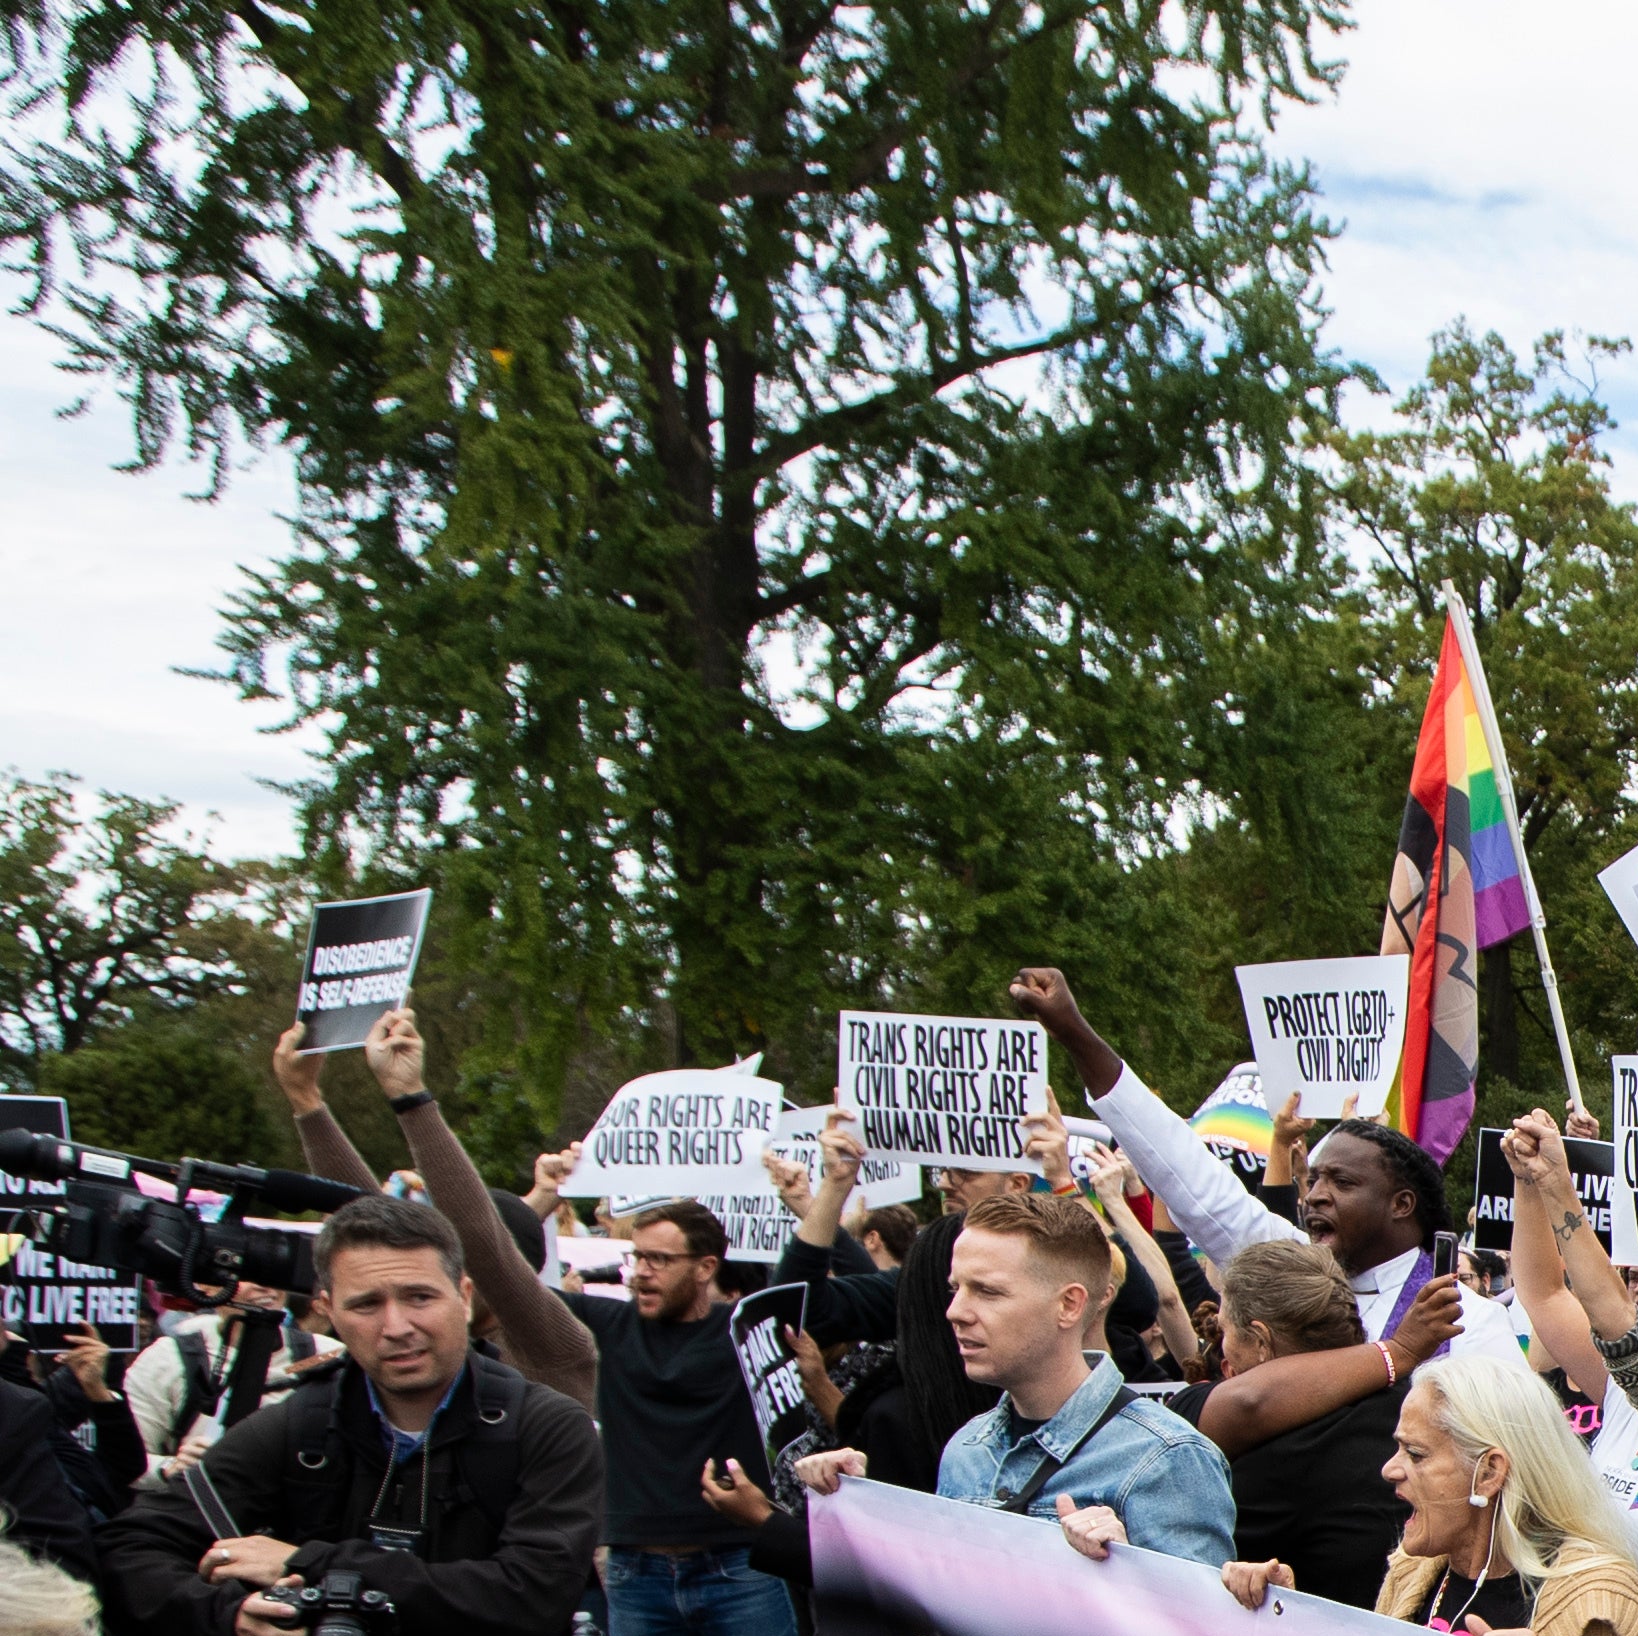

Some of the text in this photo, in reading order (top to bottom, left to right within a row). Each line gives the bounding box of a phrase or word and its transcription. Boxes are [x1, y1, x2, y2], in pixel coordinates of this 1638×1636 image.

[313, 936, 413, 975] DISOBEDIENCE
[299, 970, 409, 1011] IS SELF-DEFENSE
[1262, 990, 1395, 1041] PROTECT LGBTQ+
[848, 1021, 1038, 1073] TRANS RIGHTS ARE
[1296, 1038, 1383, 1082] CIVIL RIGHTS
[856, 1065, 1028, 1116] CIVIL RIGHTS ARE
[650, 1095, 724, 1128] RIGHTS
[732, 1098, 773, 1132] ARE
[863, 1109, 942, 1154] HUMAN
[946, 1115, 1023, 1158] RIGHTS
[594, 1130, 659, 1168] QUEER
[669, 1130, 743, 1165] RIGHTS
[16, 1238, 54, 1278] WE
[29, 1286, 84, 1324] LIVE
[87, 1286, 138, 1324] FREE
